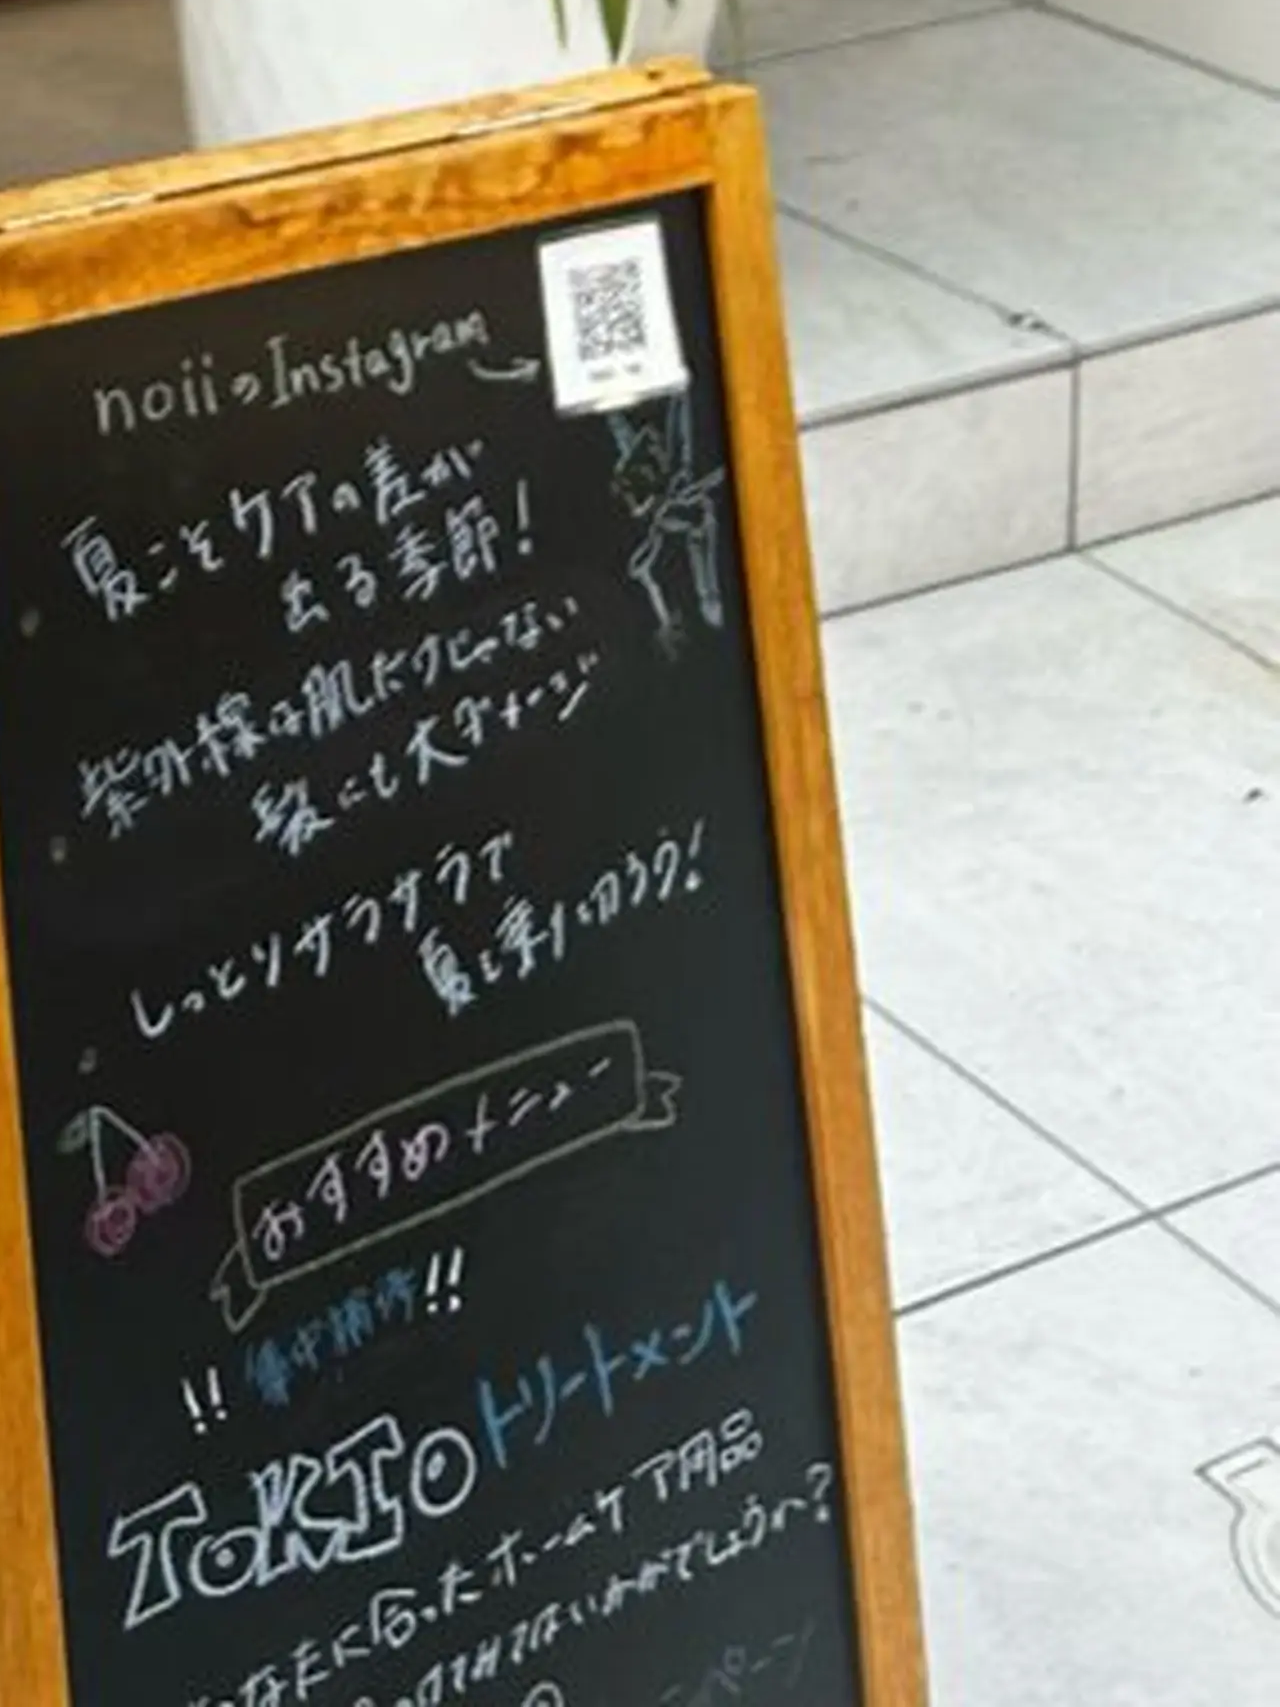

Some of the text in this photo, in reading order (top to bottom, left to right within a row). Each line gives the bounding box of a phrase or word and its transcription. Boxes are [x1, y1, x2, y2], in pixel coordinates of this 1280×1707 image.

[252, 1057, 612, 1262] おすすめメニュー
[477, 1280, 758, 1469] トリートメント
